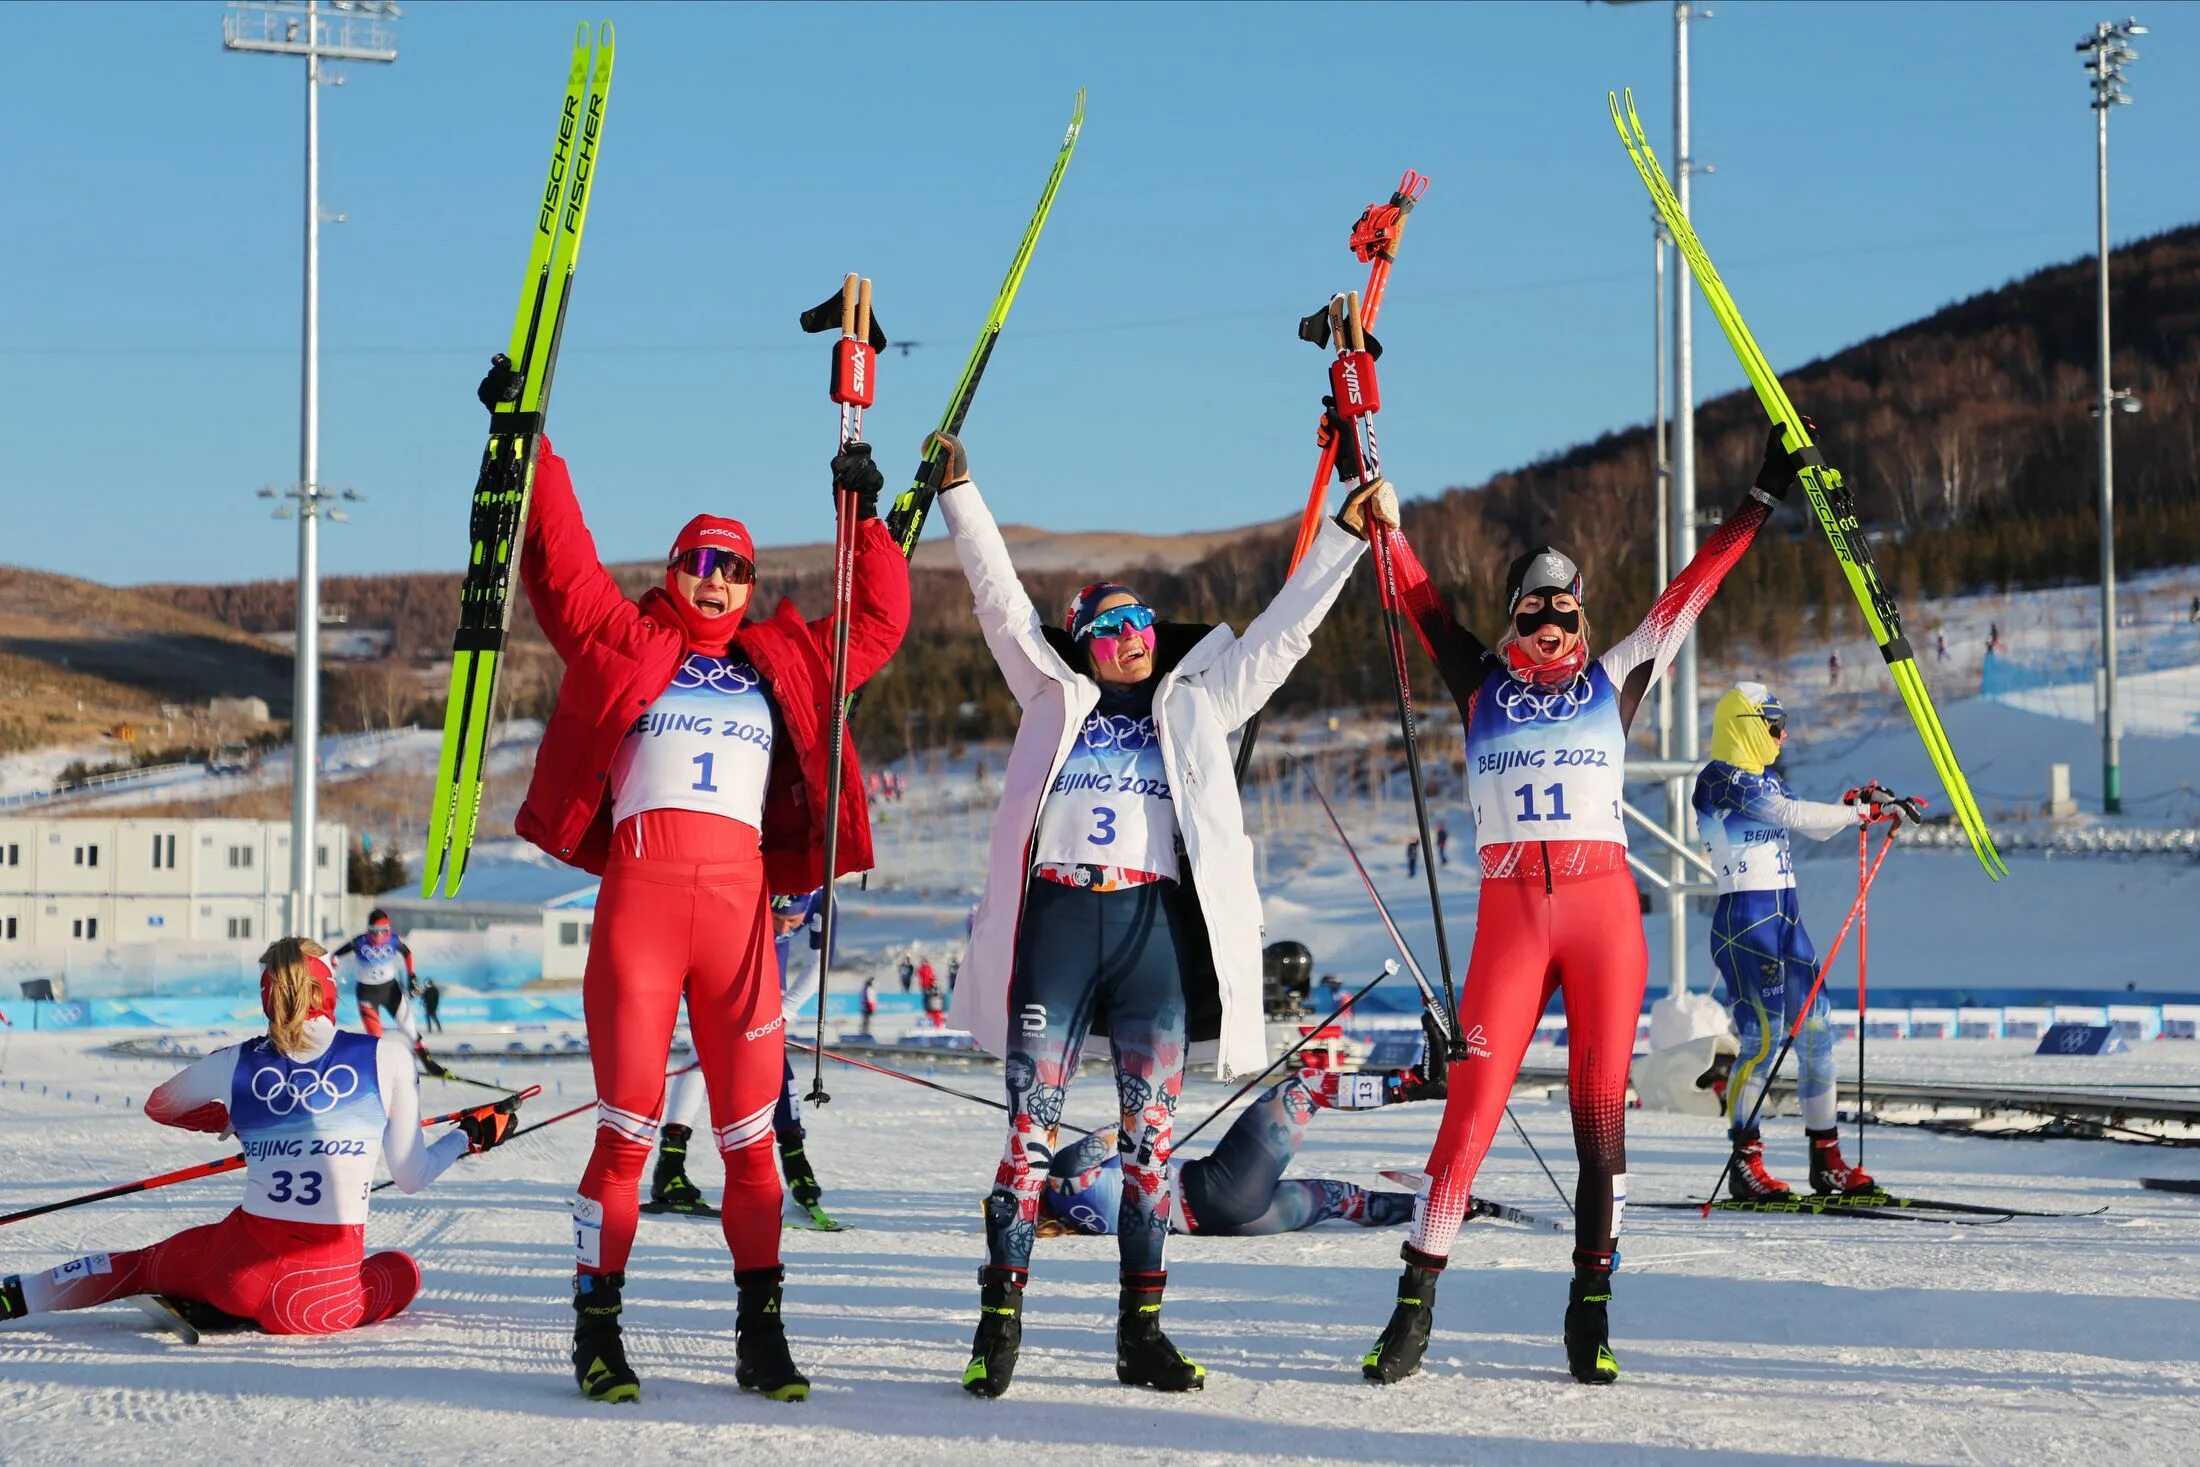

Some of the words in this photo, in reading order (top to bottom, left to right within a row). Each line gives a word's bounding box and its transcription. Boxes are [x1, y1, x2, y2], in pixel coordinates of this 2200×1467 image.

[539, 95, 579, 236] FISCHER
[565, 93, 603, 235] FISCHER
[1801, 475, 1851, 563] FISCHER
[903, 508, 923, 558] SCHER
[722, 720, 771, 752] 2022
[692, 752, 718, 793] 1
[1478, 750, 1546, 775] BEIJING
[1553, 749, 1609, 768] 2022
[1119, 777, 1174, 800] 2022
[1515, 783, 1571, 822] 11
[1611, 800, 1621, 820] 1
[1087, 806, 1117, 845] 3
[1743, 828, 1785, 843] BEIJING
[745, 1016, 782, 1042] BOSCO
[1359, 1082, 1373, 1100] 13
[244, 1140, 303, 1162] BEIJING
[310, 1140, 367, 1157] 2022
[267, 1170, 323, 1206] 33
[361, 1182, 369, 1200] 3
[1804, 1195, 1888, 1207] ISCHER
[576, 1230, 584, 1250] 1
[1396, 1297, 1422, 1307] CHER
[1583, 1293, 1613, 1303] FISCH
